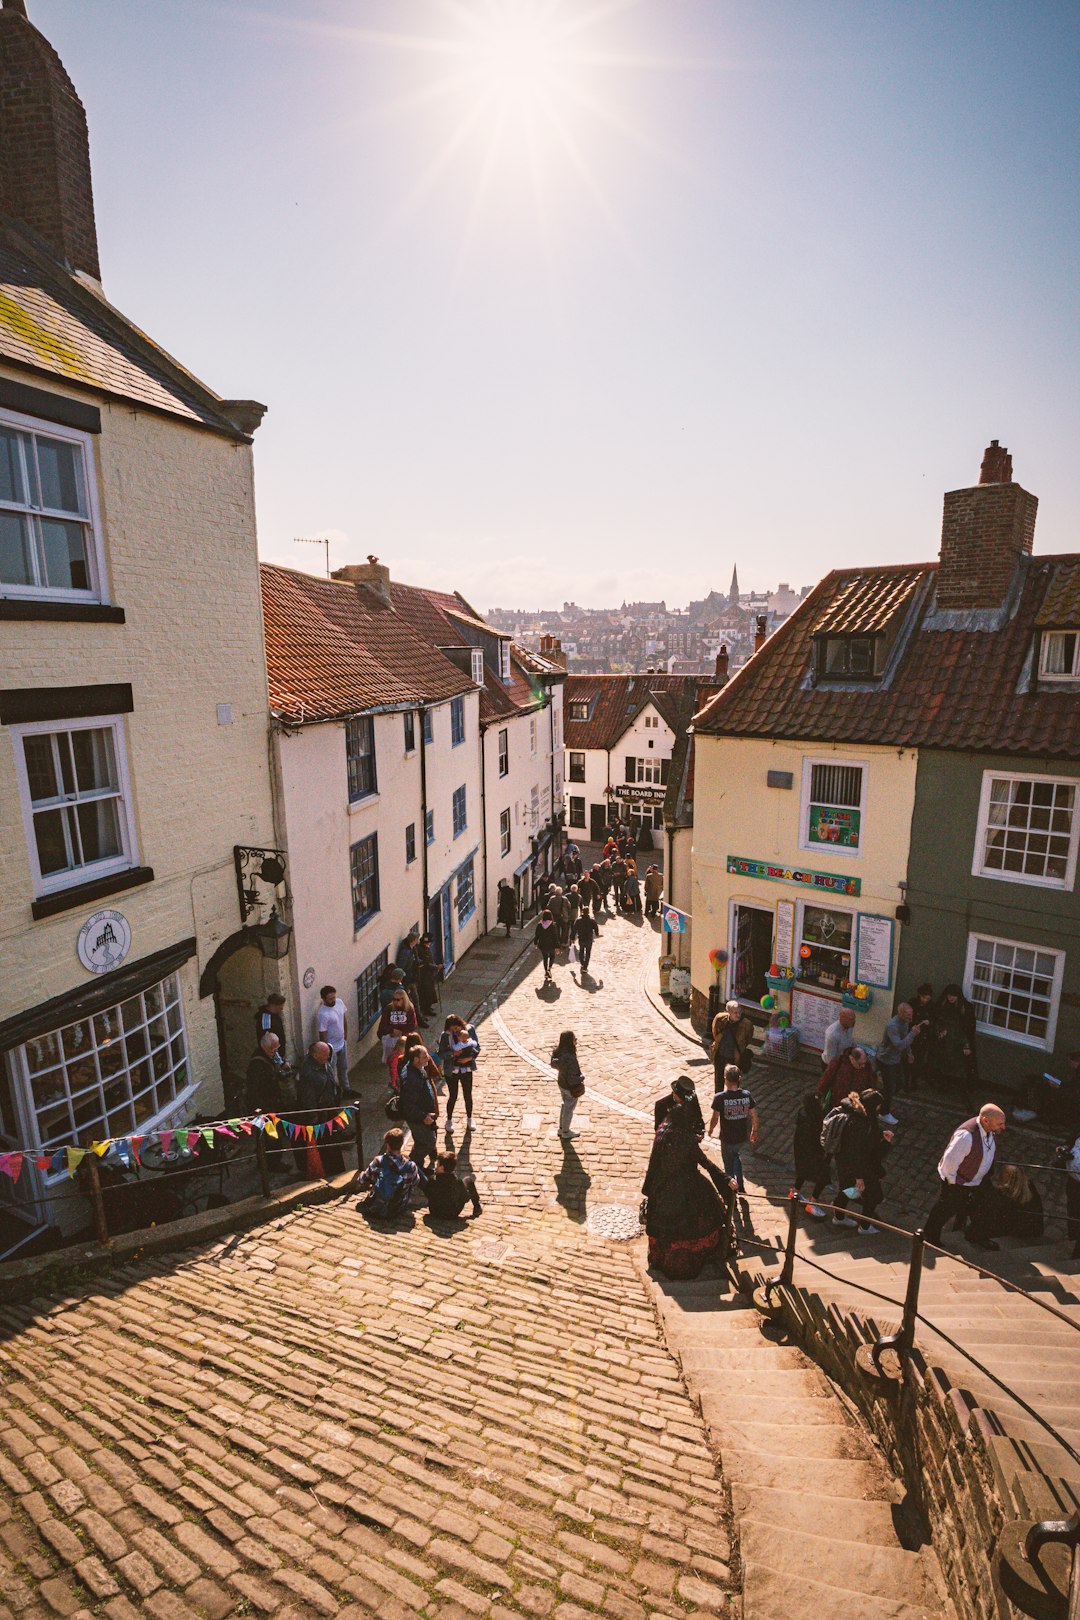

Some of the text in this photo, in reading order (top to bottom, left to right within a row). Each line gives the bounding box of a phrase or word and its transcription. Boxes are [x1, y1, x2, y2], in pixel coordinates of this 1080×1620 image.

[618, 788, 666, 799] THE BOARD INN
[740, 861, 846, 889] THE BEACH HUT
